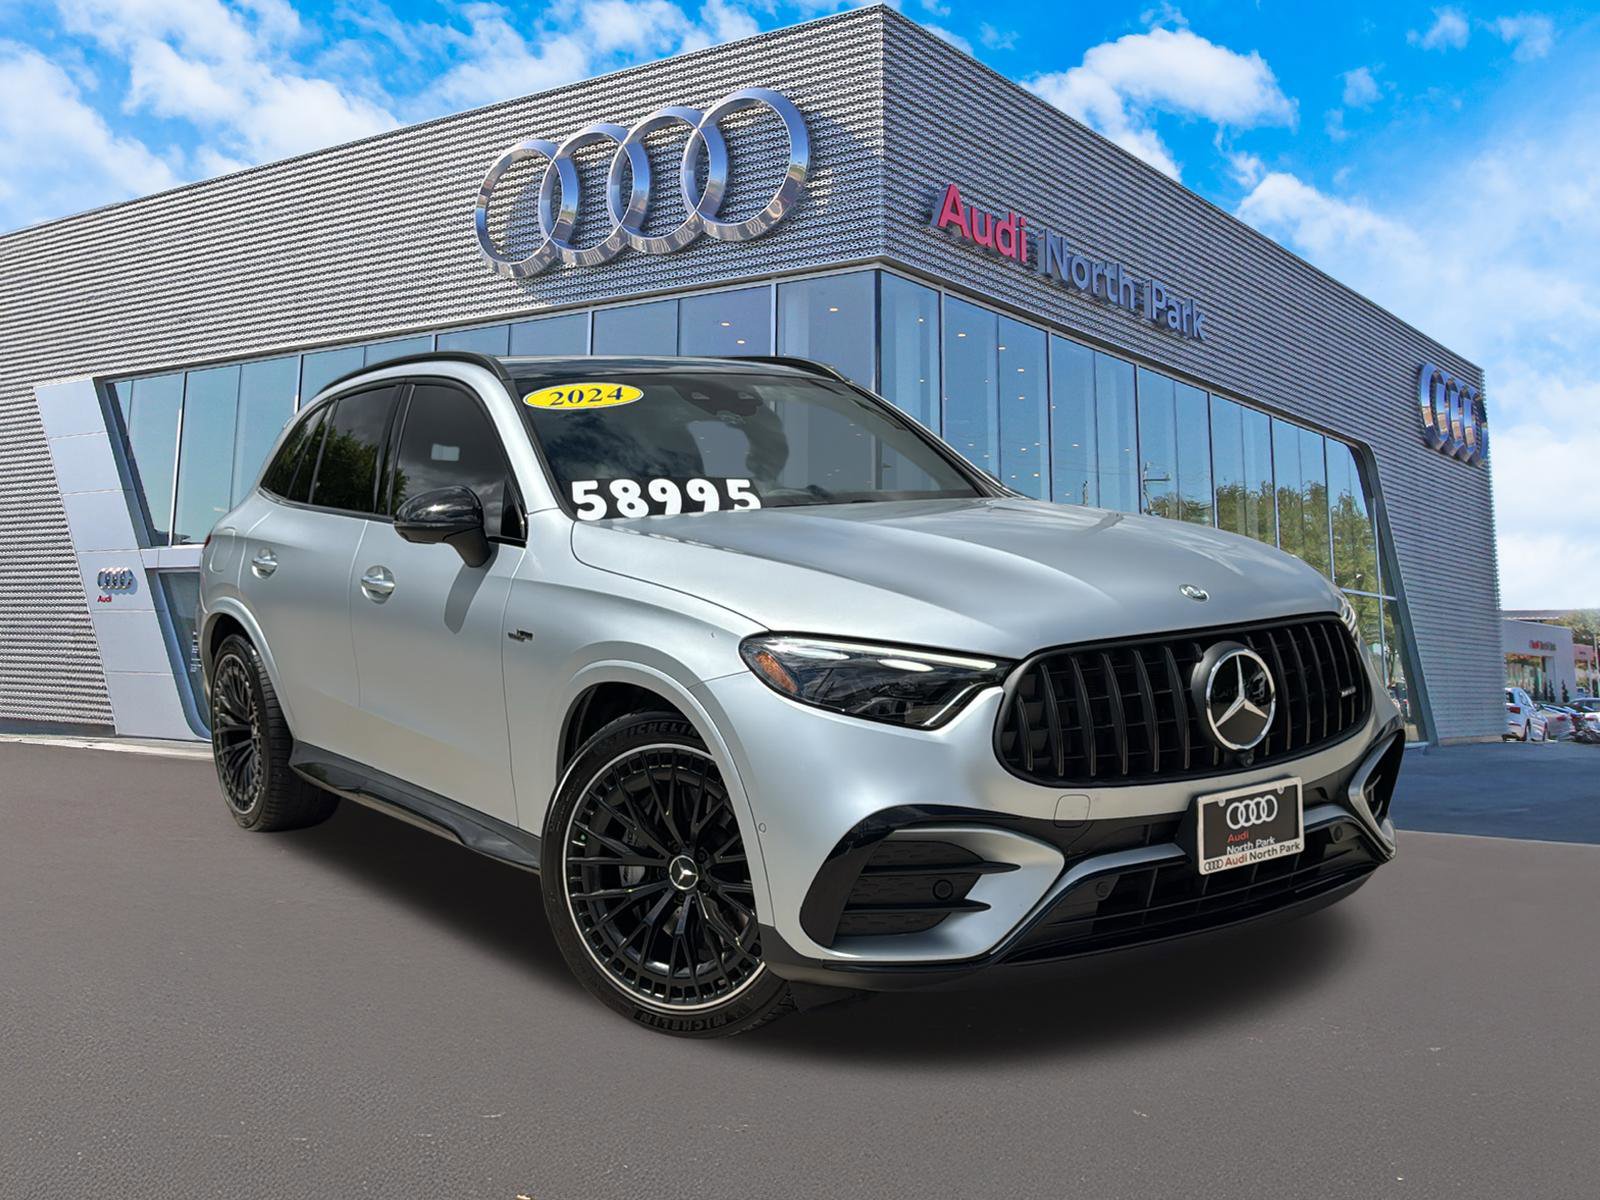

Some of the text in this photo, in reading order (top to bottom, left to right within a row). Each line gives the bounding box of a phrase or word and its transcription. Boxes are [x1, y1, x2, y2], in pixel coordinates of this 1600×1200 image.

[935, 184, 1206, 341] Audi North Park
[550, 387, 624, 406] 2024
[571, 478, 762, 521] 58995
[617, 721, 698, 738] ICHELIN
[1226, 836, 1275, 855] North Park
[1228, 831, 1249, 843] Audi
[1225, 841, 1300, 868] Audi North Park
